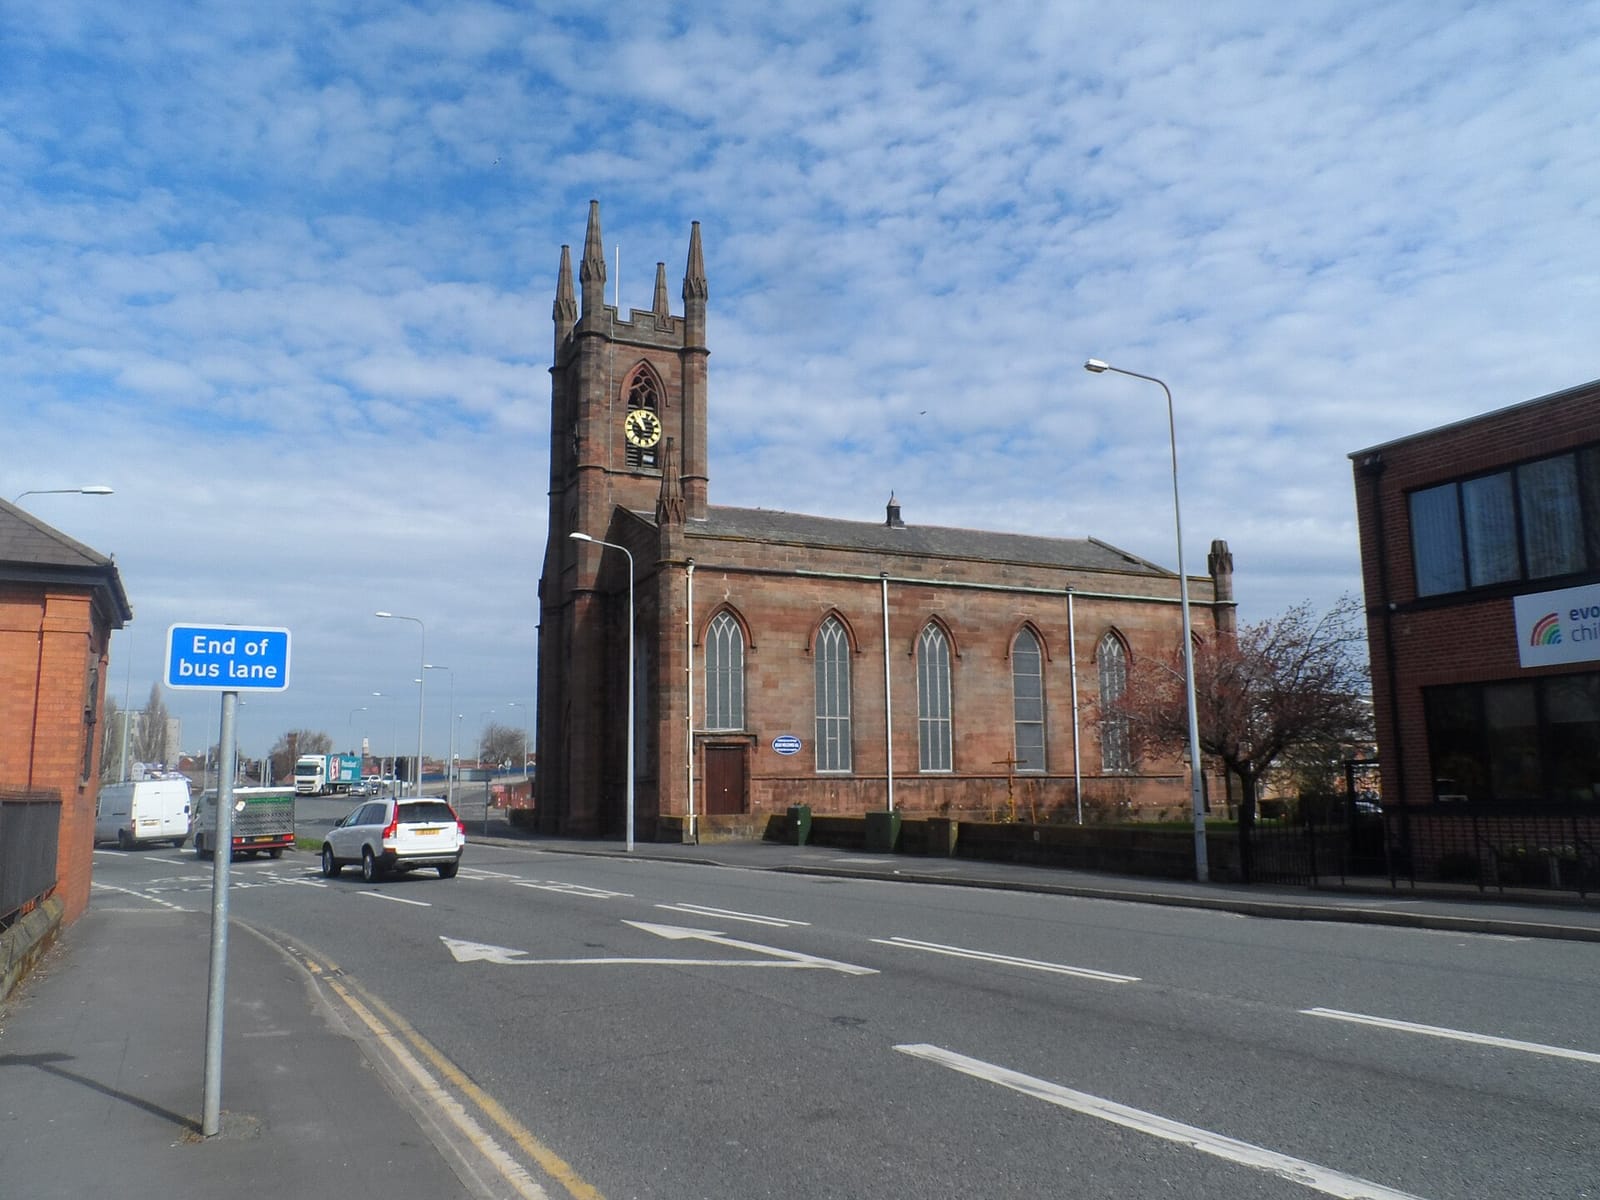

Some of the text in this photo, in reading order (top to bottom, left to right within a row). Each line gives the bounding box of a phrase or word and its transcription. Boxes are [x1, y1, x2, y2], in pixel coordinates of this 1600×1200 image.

[192, 635, 269, 656] End of
[179, 658, 278, 679] bus lane
